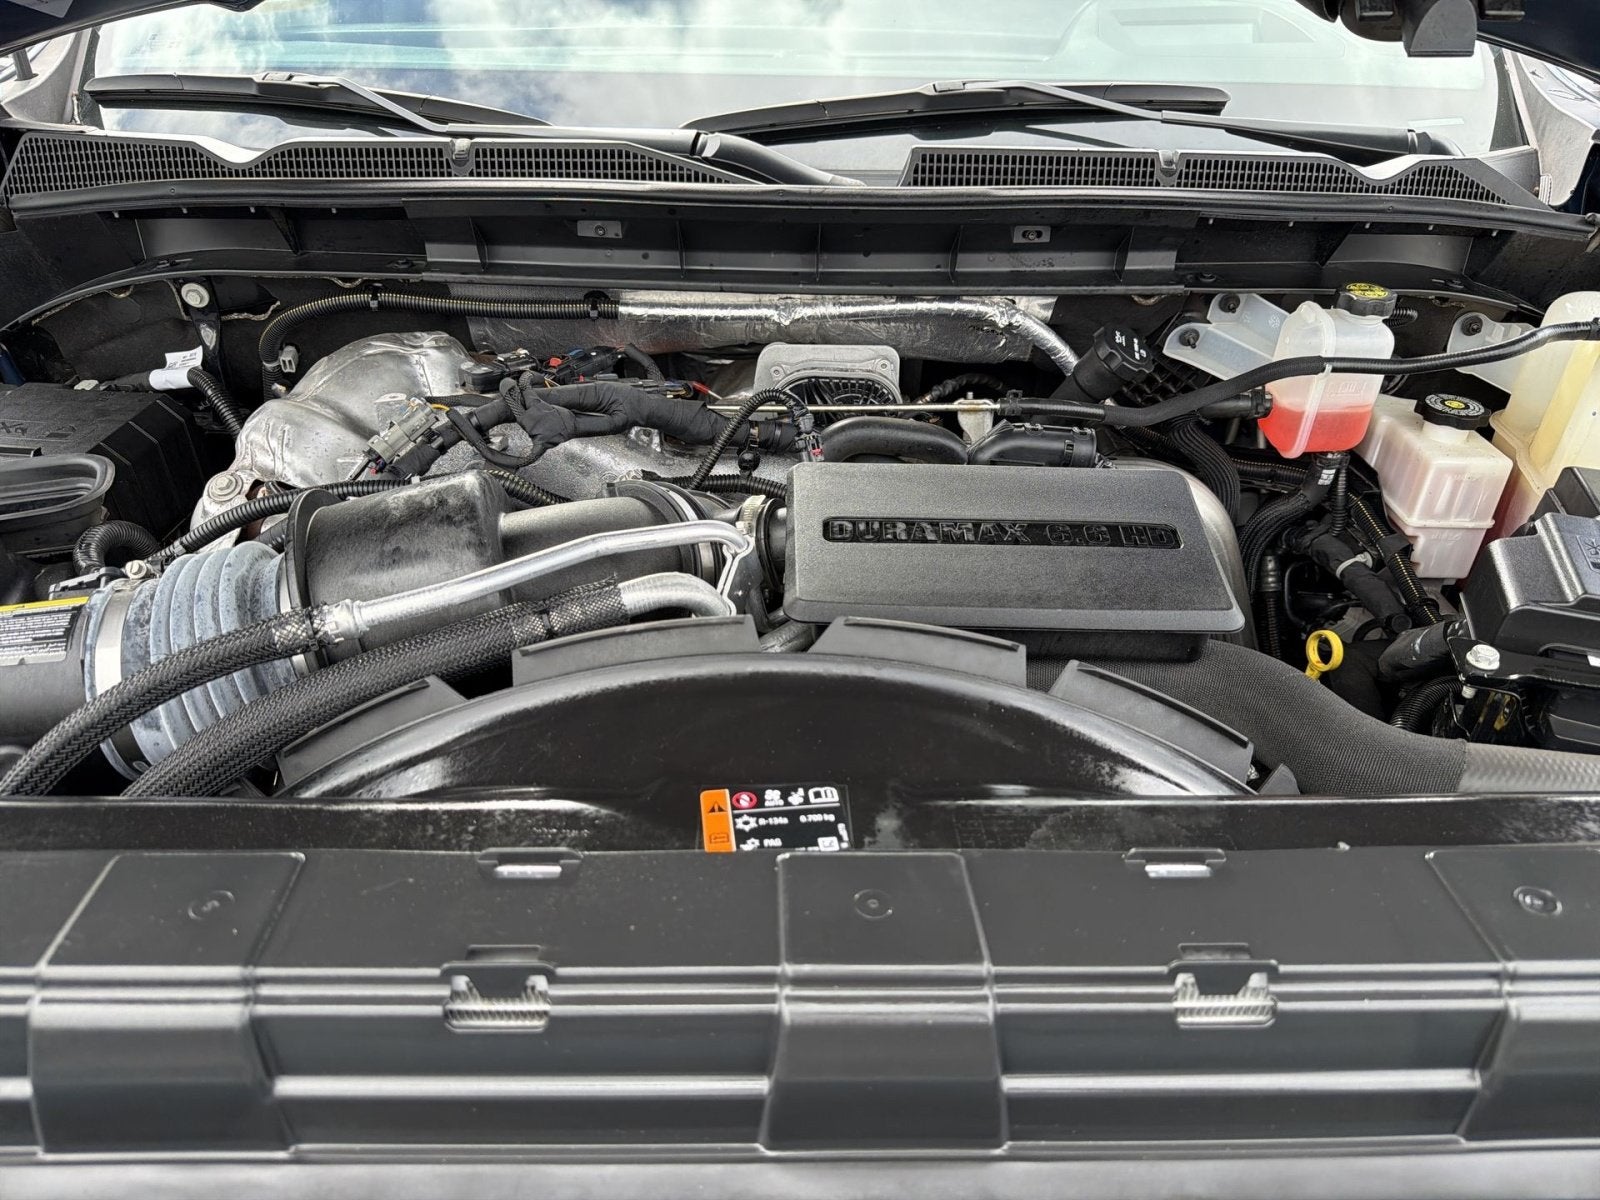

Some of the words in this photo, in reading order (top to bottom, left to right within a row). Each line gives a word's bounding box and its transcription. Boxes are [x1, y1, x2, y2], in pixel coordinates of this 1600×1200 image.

[828, 520, 1031, 543] DURAMAX
[1046, 522, 1111, 545] 6.6
[1118, 525, 1178, 547] HD
